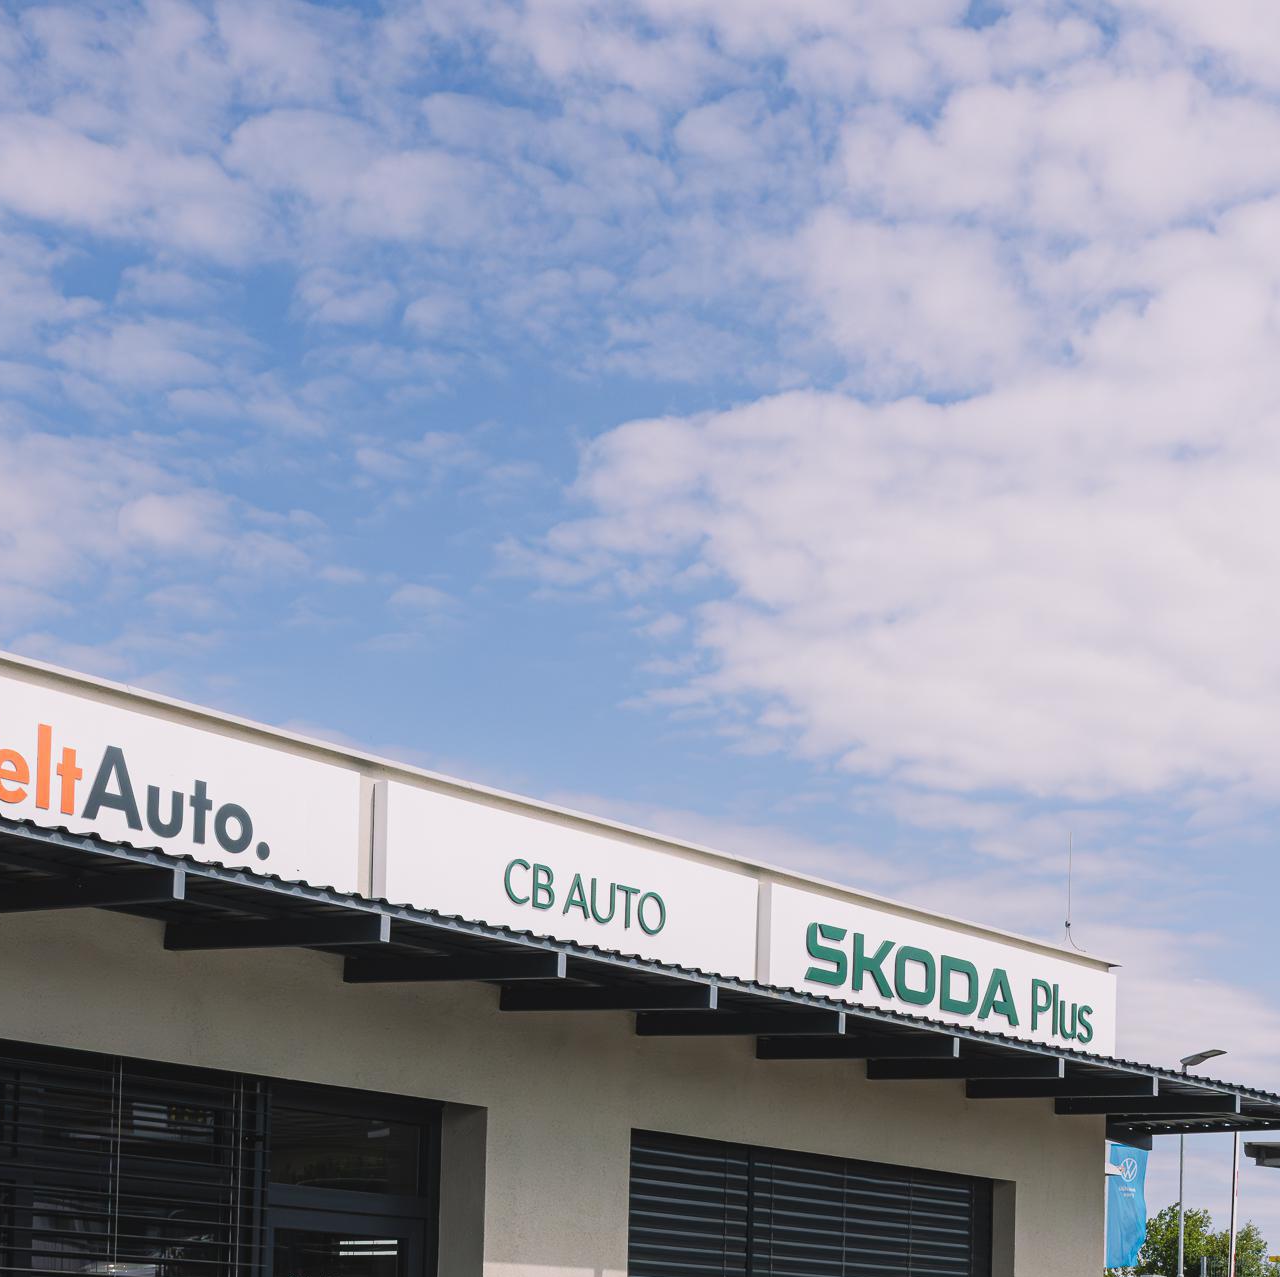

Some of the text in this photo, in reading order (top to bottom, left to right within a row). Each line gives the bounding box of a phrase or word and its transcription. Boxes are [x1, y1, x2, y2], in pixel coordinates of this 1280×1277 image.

[504, 858, 667, 936] CB AUTO
[805, 921, 1094, 1045] SKODA Plus
